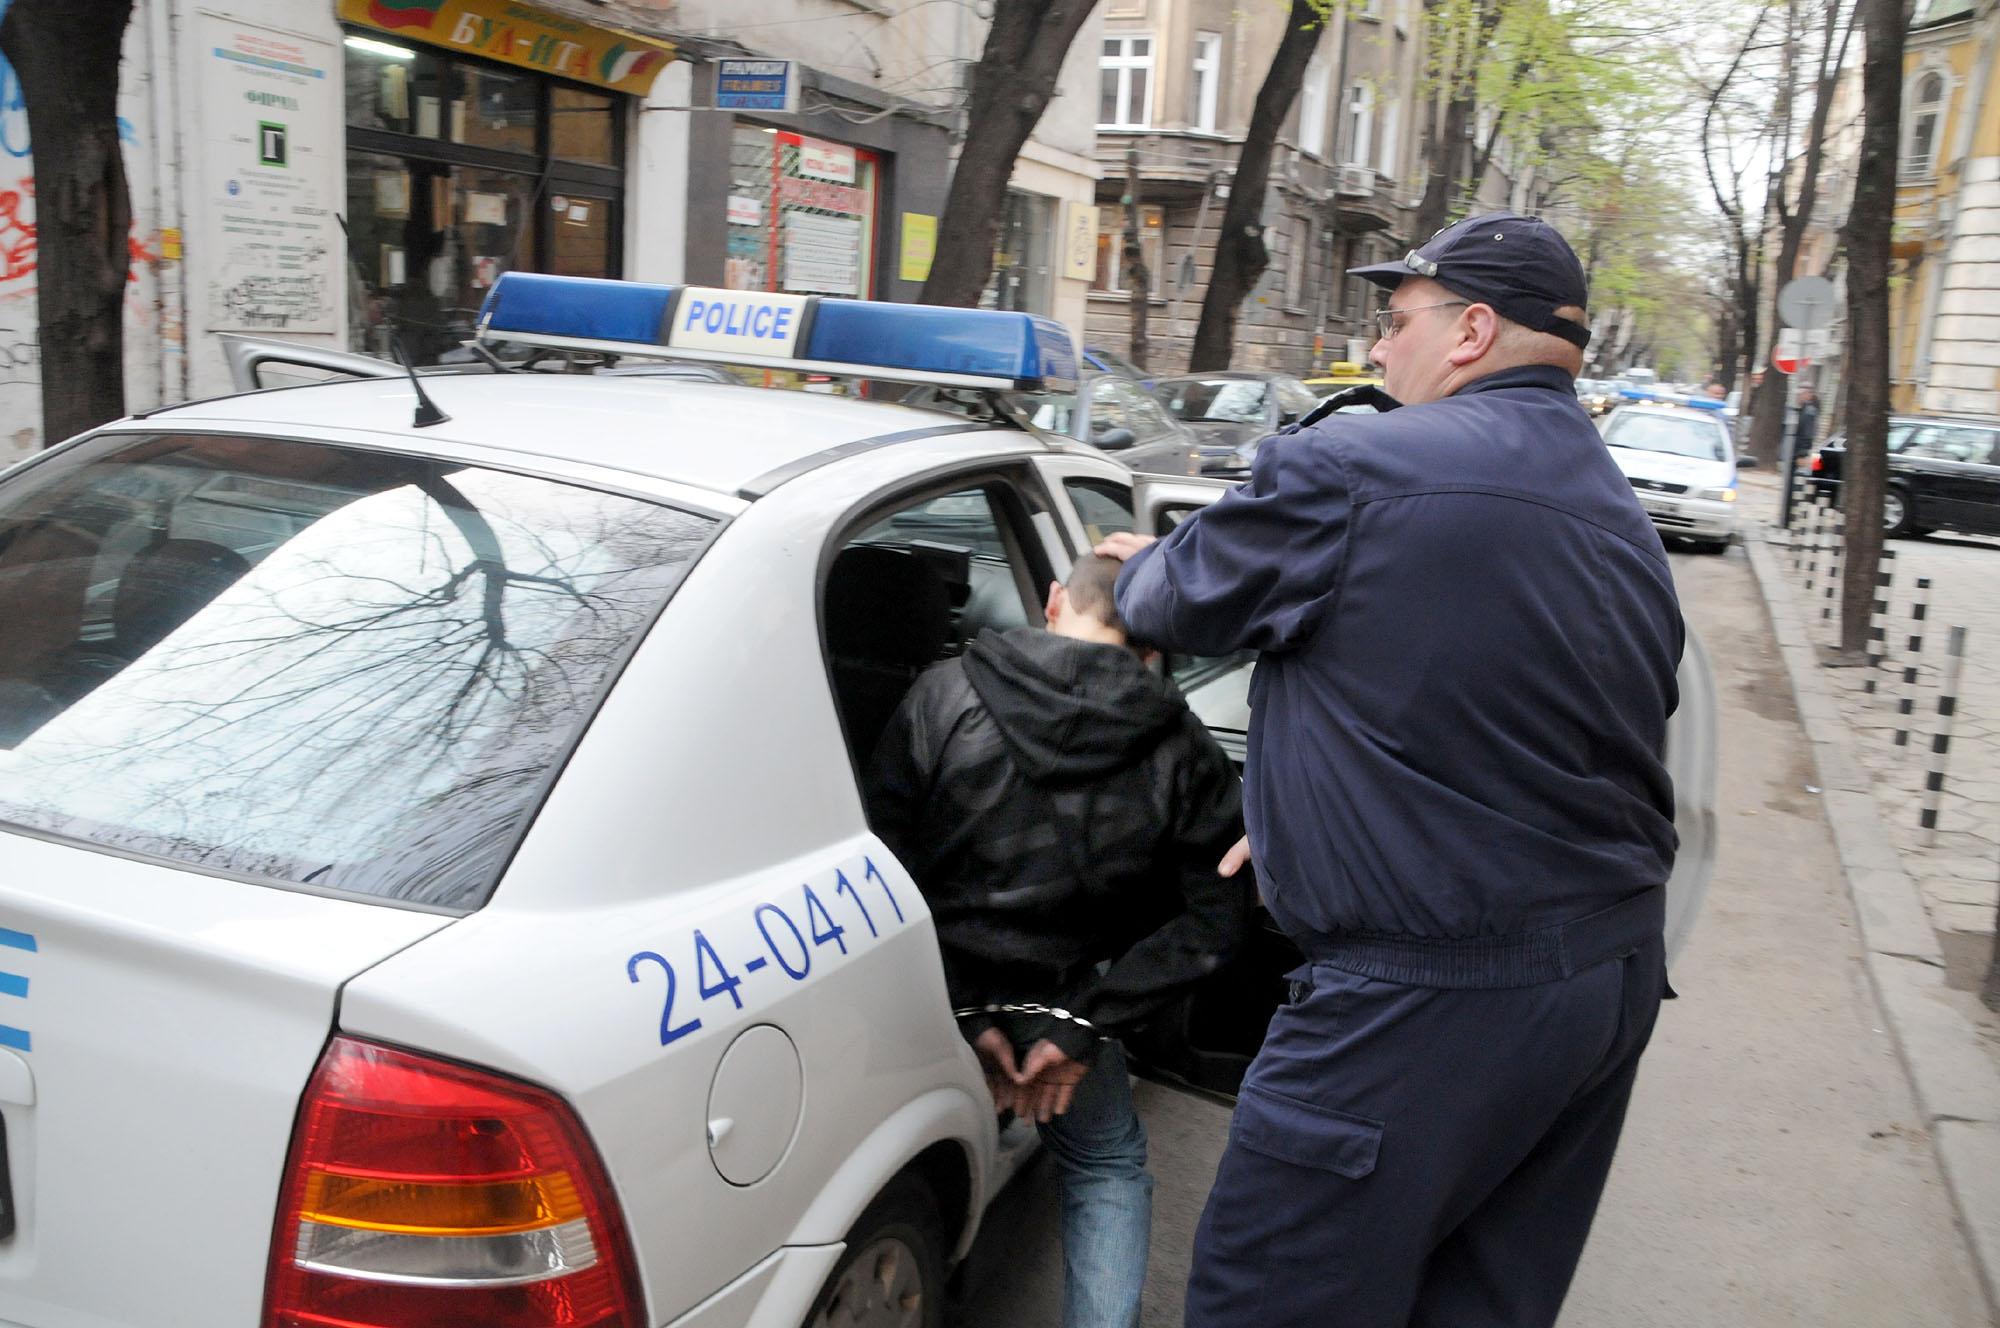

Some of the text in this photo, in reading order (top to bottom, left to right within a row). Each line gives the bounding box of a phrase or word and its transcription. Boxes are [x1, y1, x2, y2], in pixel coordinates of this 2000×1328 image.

[448, 12, 592, 77] БУЛ-ИТА
[685, 300, 793, 339] POLICE
[627, 856, 905, 1046] 24-0411
